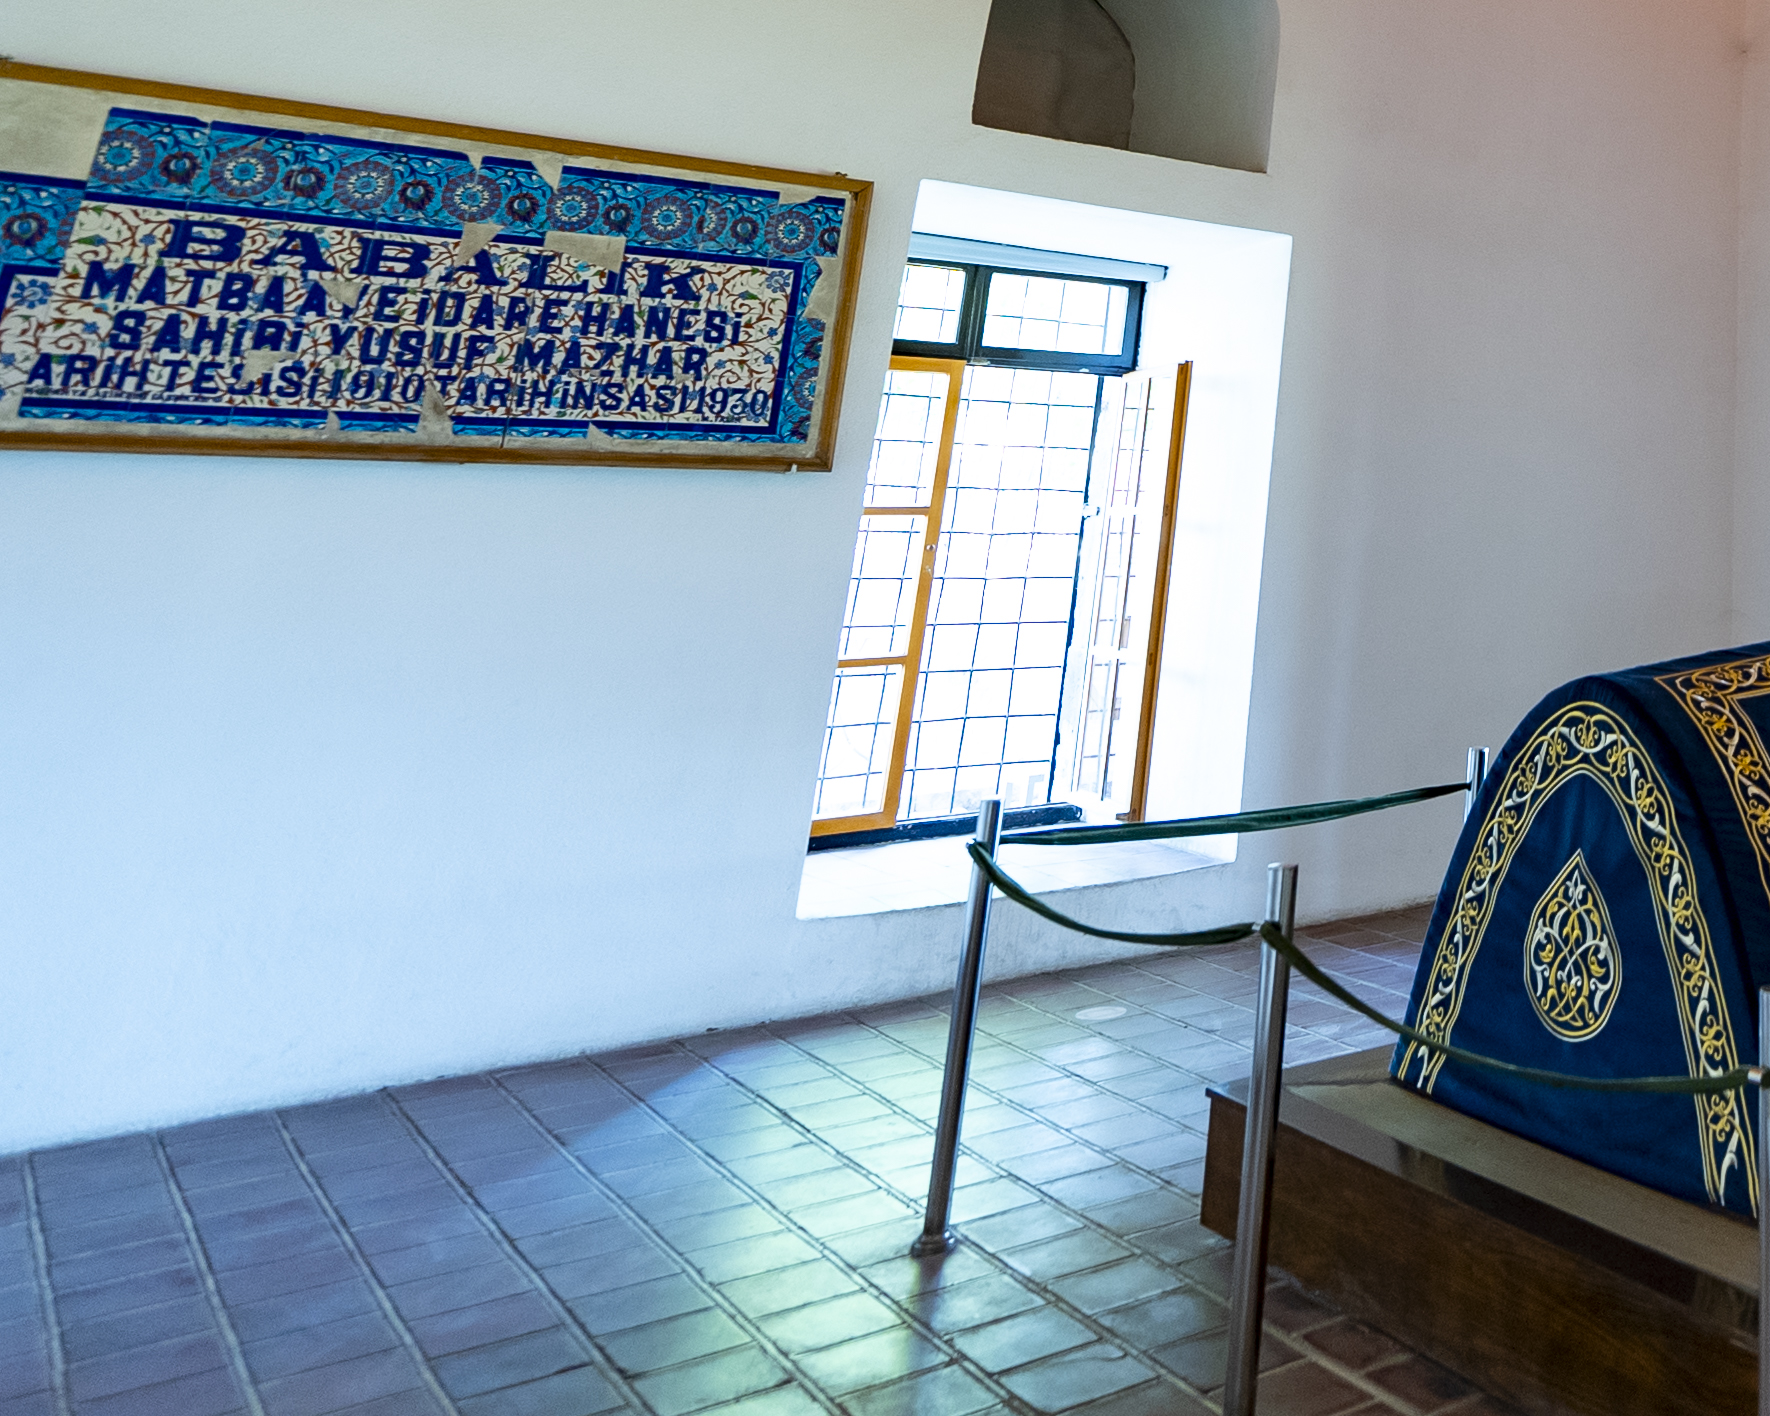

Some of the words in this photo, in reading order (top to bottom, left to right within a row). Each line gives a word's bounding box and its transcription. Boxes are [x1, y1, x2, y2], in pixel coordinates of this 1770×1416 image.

[160, 218, 705, 301] BABALIK
[80, 261, 327, 319] MATBAA
[330, 322, 495, 371] YUSUF
[514, 337, 708, 383] MAZHAR
[327, 367, 425, 405] 1910
[697, 385, 769, 417] 1930
